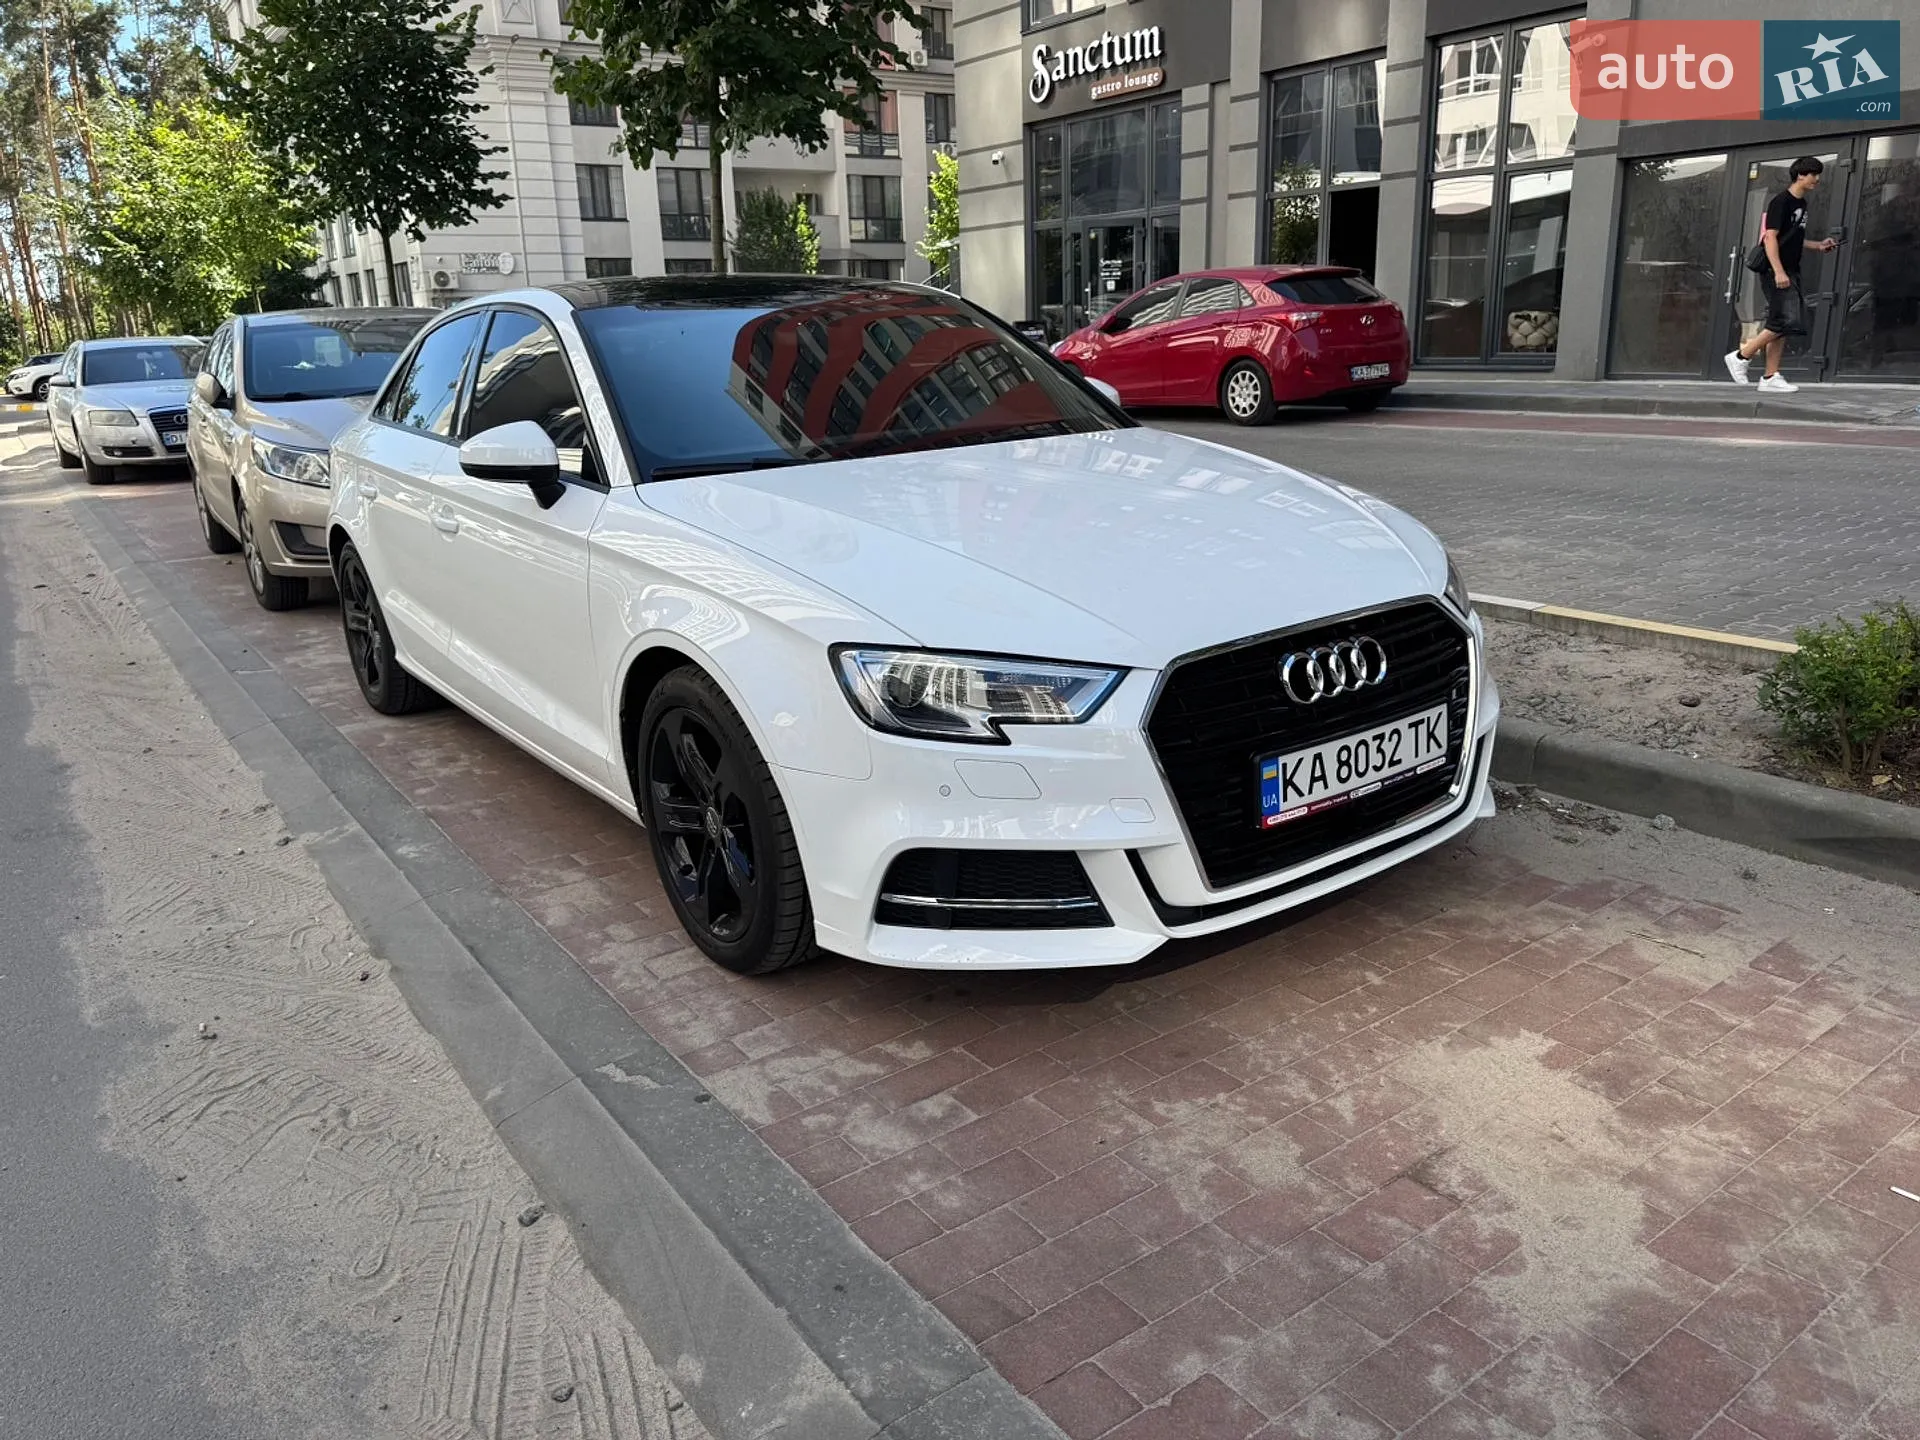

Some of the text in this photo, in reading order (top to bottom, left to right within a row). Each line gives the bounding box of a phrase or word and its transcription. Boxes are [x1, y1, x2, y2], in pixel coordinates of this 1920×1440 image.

[1029, 25, 1162, 104] Sanctum
[1091, 71, 1159, 100] gastro lounge
[1281, 711, 1443, 803] KA 8032 TK
[1262, 793, 1278, 808] UA
